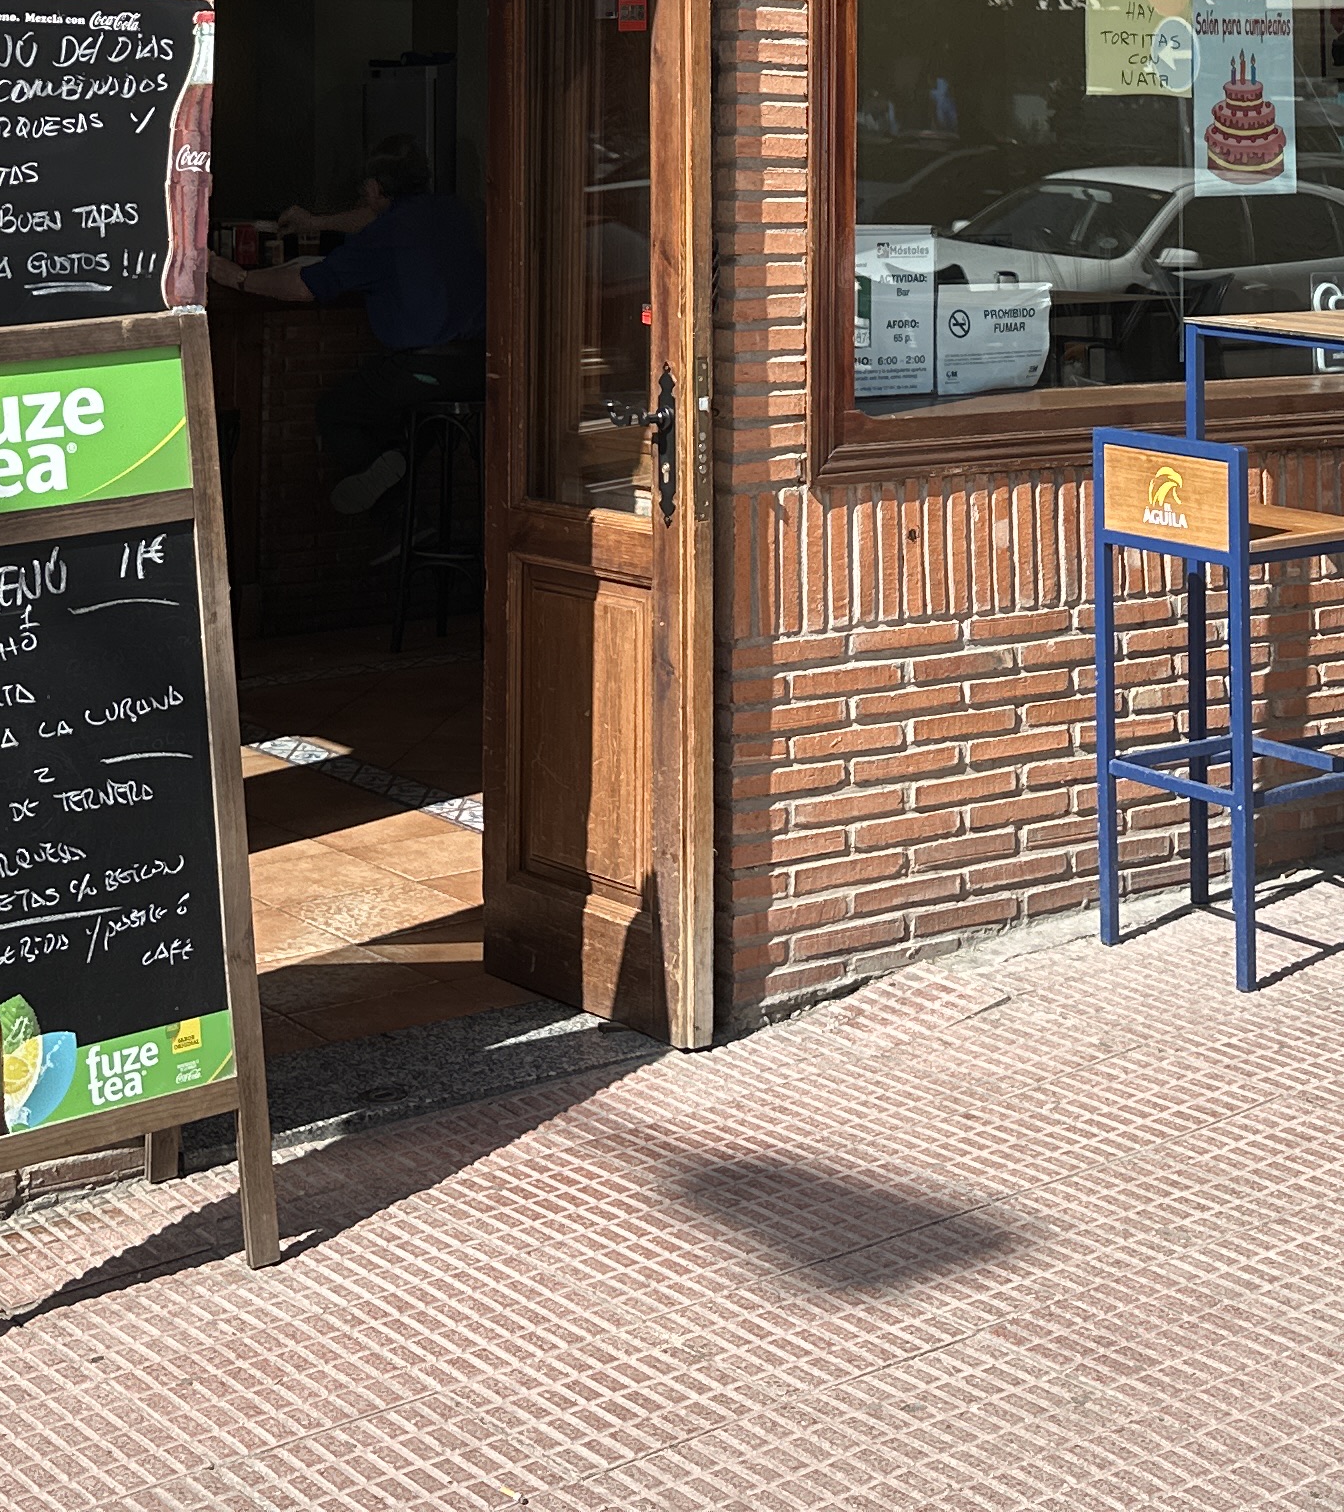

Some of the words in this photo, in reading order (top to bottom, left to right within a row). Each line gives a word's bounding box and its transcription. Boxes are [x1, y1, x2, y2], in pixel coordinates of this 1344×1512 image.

[25, 13, 64, 24] Mezcla
[65, 16, 86, 25] con
[1125, 1, 1155, 23] HAY
[1195, 10, 1220, 37] Salón
[1222, 17, 1242, 42] para
[1244, 12, 1291, 43] cumpleaños
[1100, 30, 1181, 50] TORTITAS
[1128, 53, 1160, 65] CON
[1121, 70, 1169, 88] NATA
[130, 106, 156, 134] Y
[71, 202, 139, 238] TAPAS
[889, 245, 929, 255] Móstoles
[26, 251, 111, 278] GUSTOS
[896, 288, 910, 296] Bar
[983, 308, 1036, 319] PROHIBIDO
[886, 319, 919, 329] AFORO:
[993, 322, 1026, 333] FUMAR
[877, 355, 898, 365] 6:00
[905, 354, 926, 364] 2:00
[0, 728, 19, 749] A
[33, 767, 56, 783] 2
[8, 798, 40, 823] DE
[53, 778, 154, 812] TERNERA
[86, 1042, 159, 1078] fuze
[88, 1070, 144, 1106] tea
